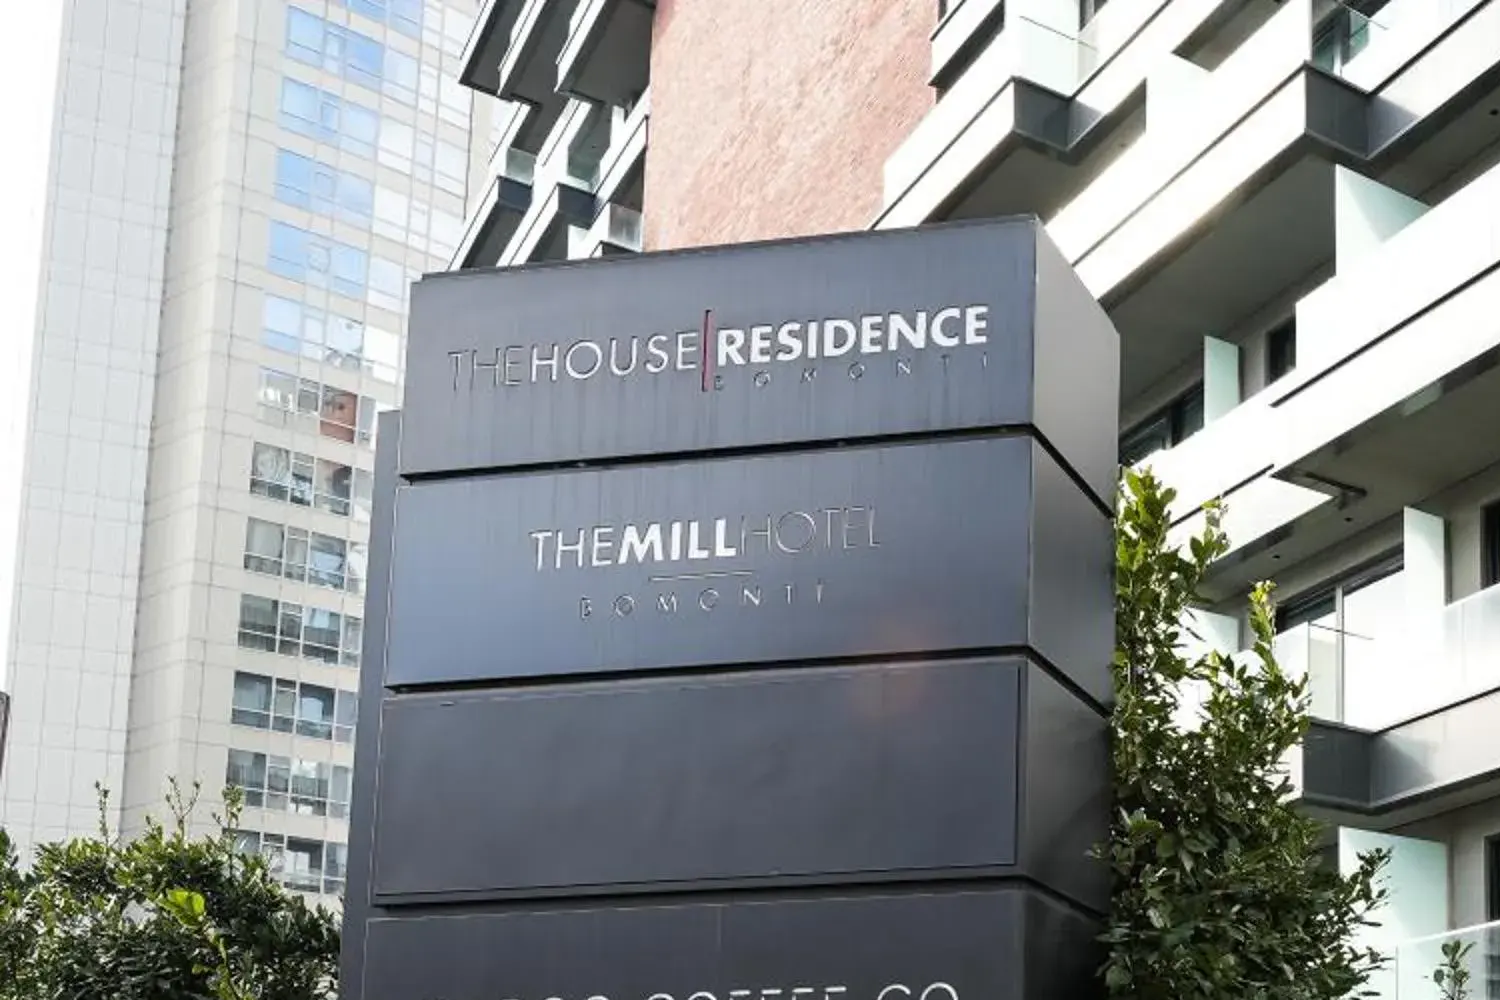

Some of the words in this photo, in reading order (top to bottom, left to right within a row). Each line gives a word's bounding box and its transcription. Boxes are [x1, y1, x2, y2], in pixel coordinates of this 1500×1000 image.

[715, 304, 990, 367] RESIDENCE
[713, 350, 989, 392] BOMONTI
[579, 579, 824, 621] BOMONTI
